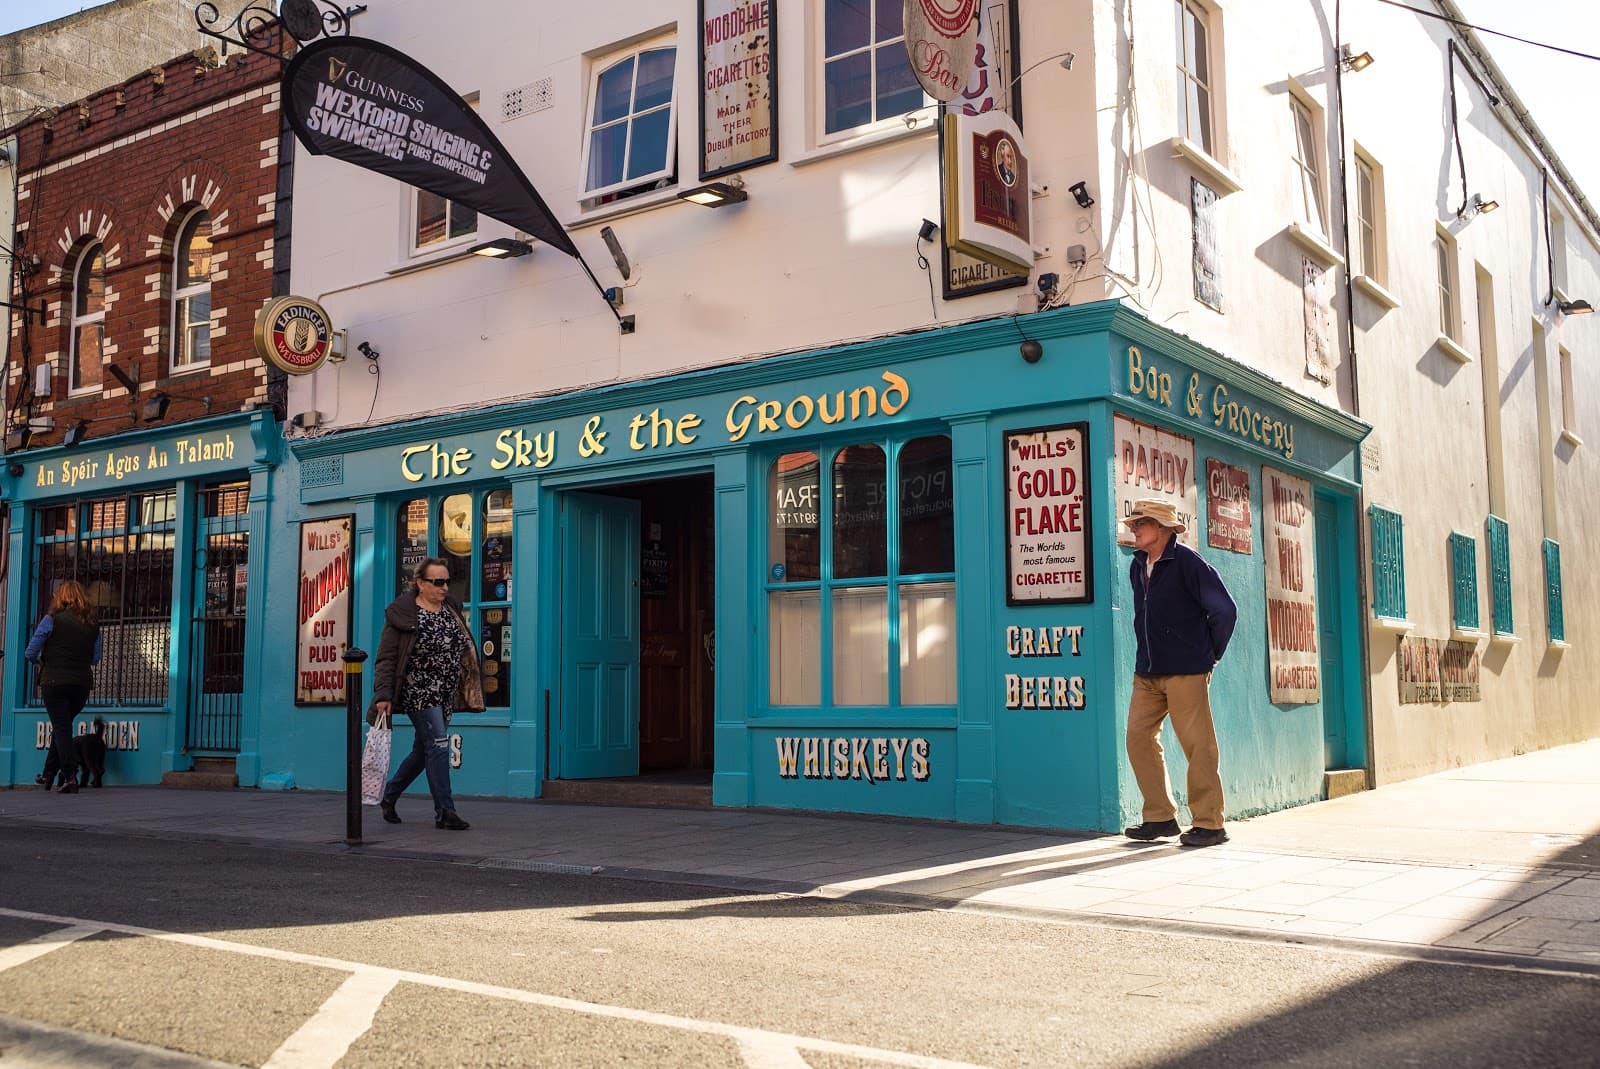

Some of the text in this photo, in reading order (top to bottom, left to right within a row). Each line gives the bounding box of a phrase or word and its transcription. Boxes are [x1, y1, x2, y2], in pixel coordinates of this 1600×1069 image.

[705, 1, 768, 47] WOODBINE
[707, 53, 768, 90] CIGARETTES
[914, 40, 960, 91] Bar
[345, 70, 425, 112] GUINNESS
[717, 99, 758, 119] MADE AT
[723, 117, 752, 133] THEIR
[407, 143, 432, 161] PUBS
[707, 127, 769, 153] DUBLIN FACTORY
[479, 150, 492, 171] &
[278, 306, 326, 336] ERDINGER
[1186, 372, 1204, 418] &
[400, 442, 473, 482] The
[490, 428, 556, 470] Sky
[578, 415, 607, 458] &
[628, 408, 702, 450] the
[36, 434, 234, 487] An Spéir Agus An Talamh
[1122, 440, 1188, 498] PADDY
[1020, 542, 1065, 553] The World's
[1023, 555, 1076, 565] most famous
[1016, 571, 1082, 586] CIGARETTE
[313, 620, 335, 638] CUT
[1006, 625, 1084, 658] CRAFT
[309, 646, 337, 663] PLUG
[301, 670, 344, 689] TOBACCO
[1276, 664, 1318, 690] CIGARETTES
[1005, 673, 1086, 711] BEERS
[775, 736, 931, 785] WHISKEYS
